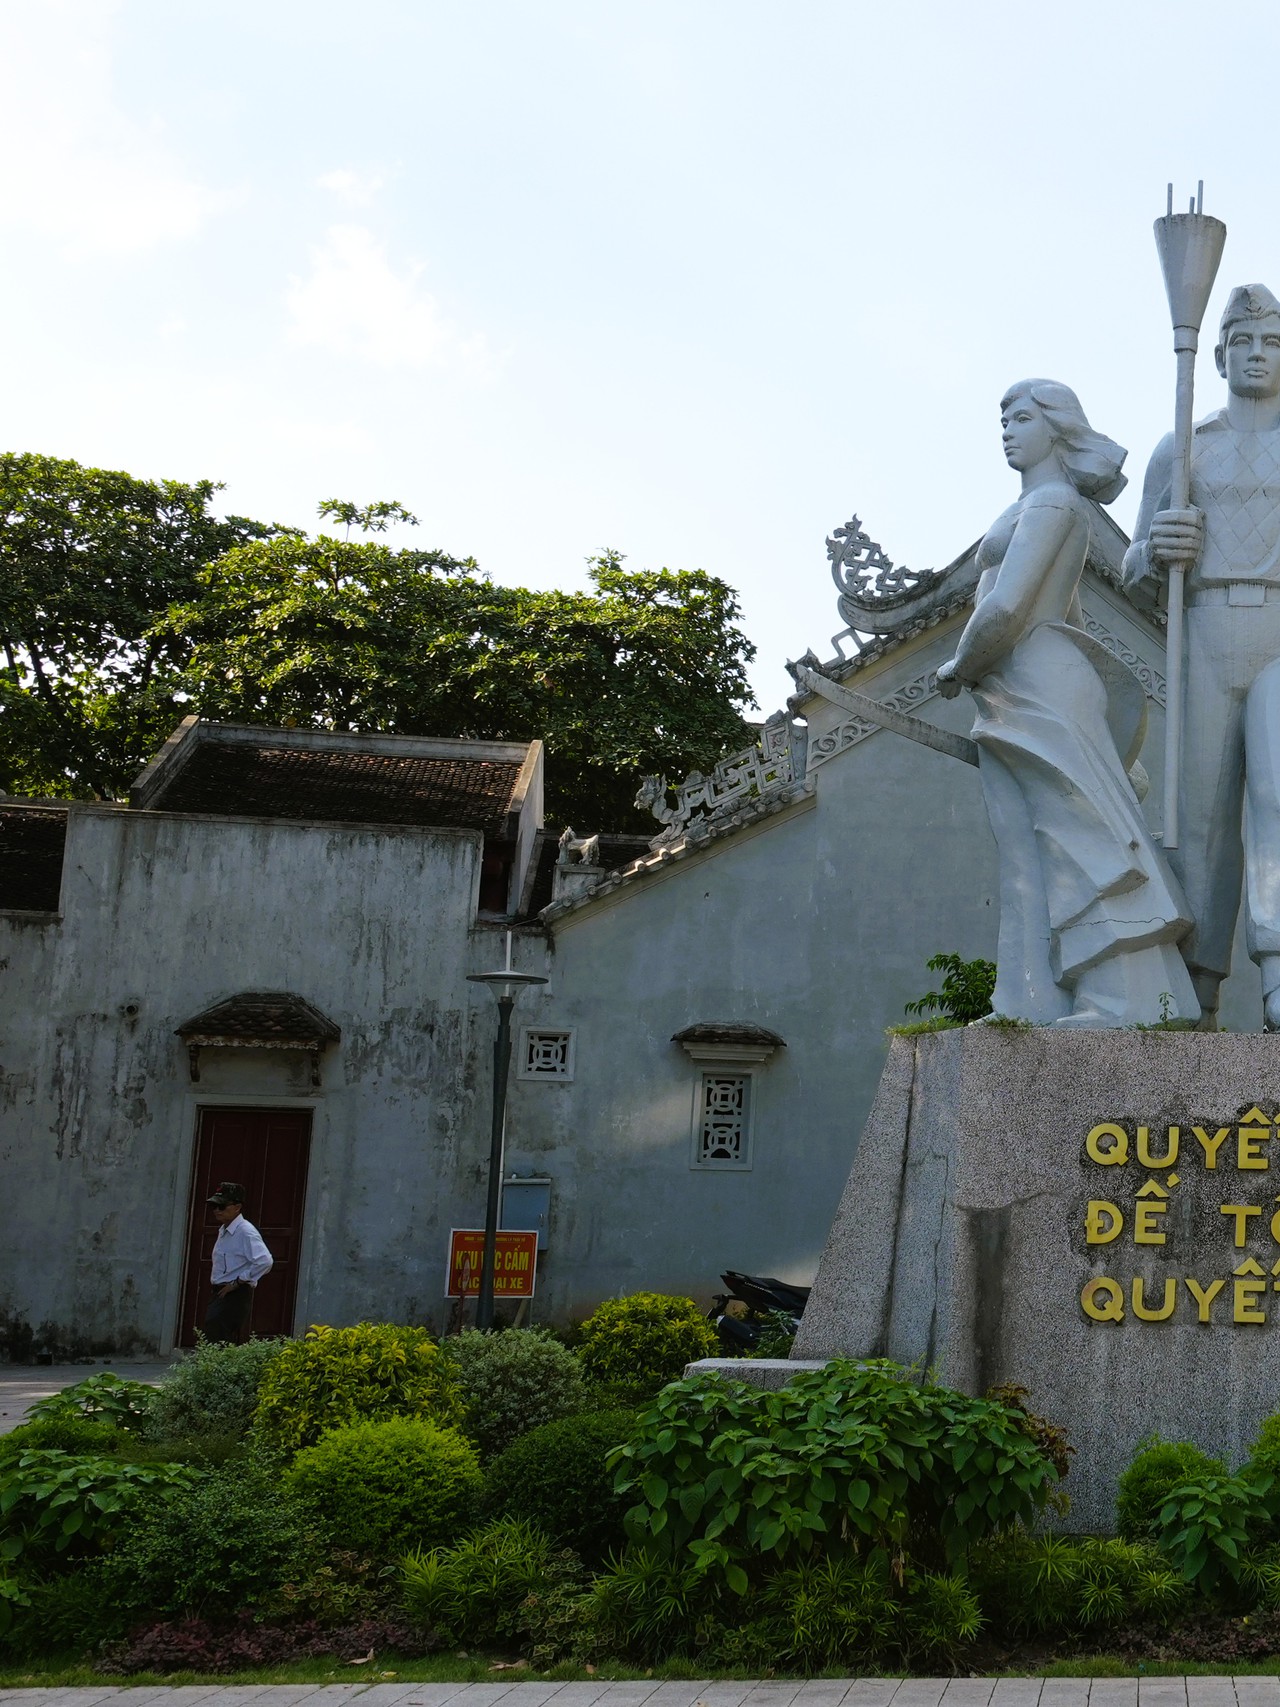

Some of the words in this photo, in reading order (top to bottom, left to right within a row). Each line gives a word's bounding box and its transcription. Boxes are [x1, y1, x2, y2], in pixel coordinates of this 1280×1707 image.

[1084, 1173, 1181, 1245] ĐỂ
[504, 1245, 530, 1271] CẤM
[509, 1277, 524, 1289] XE
